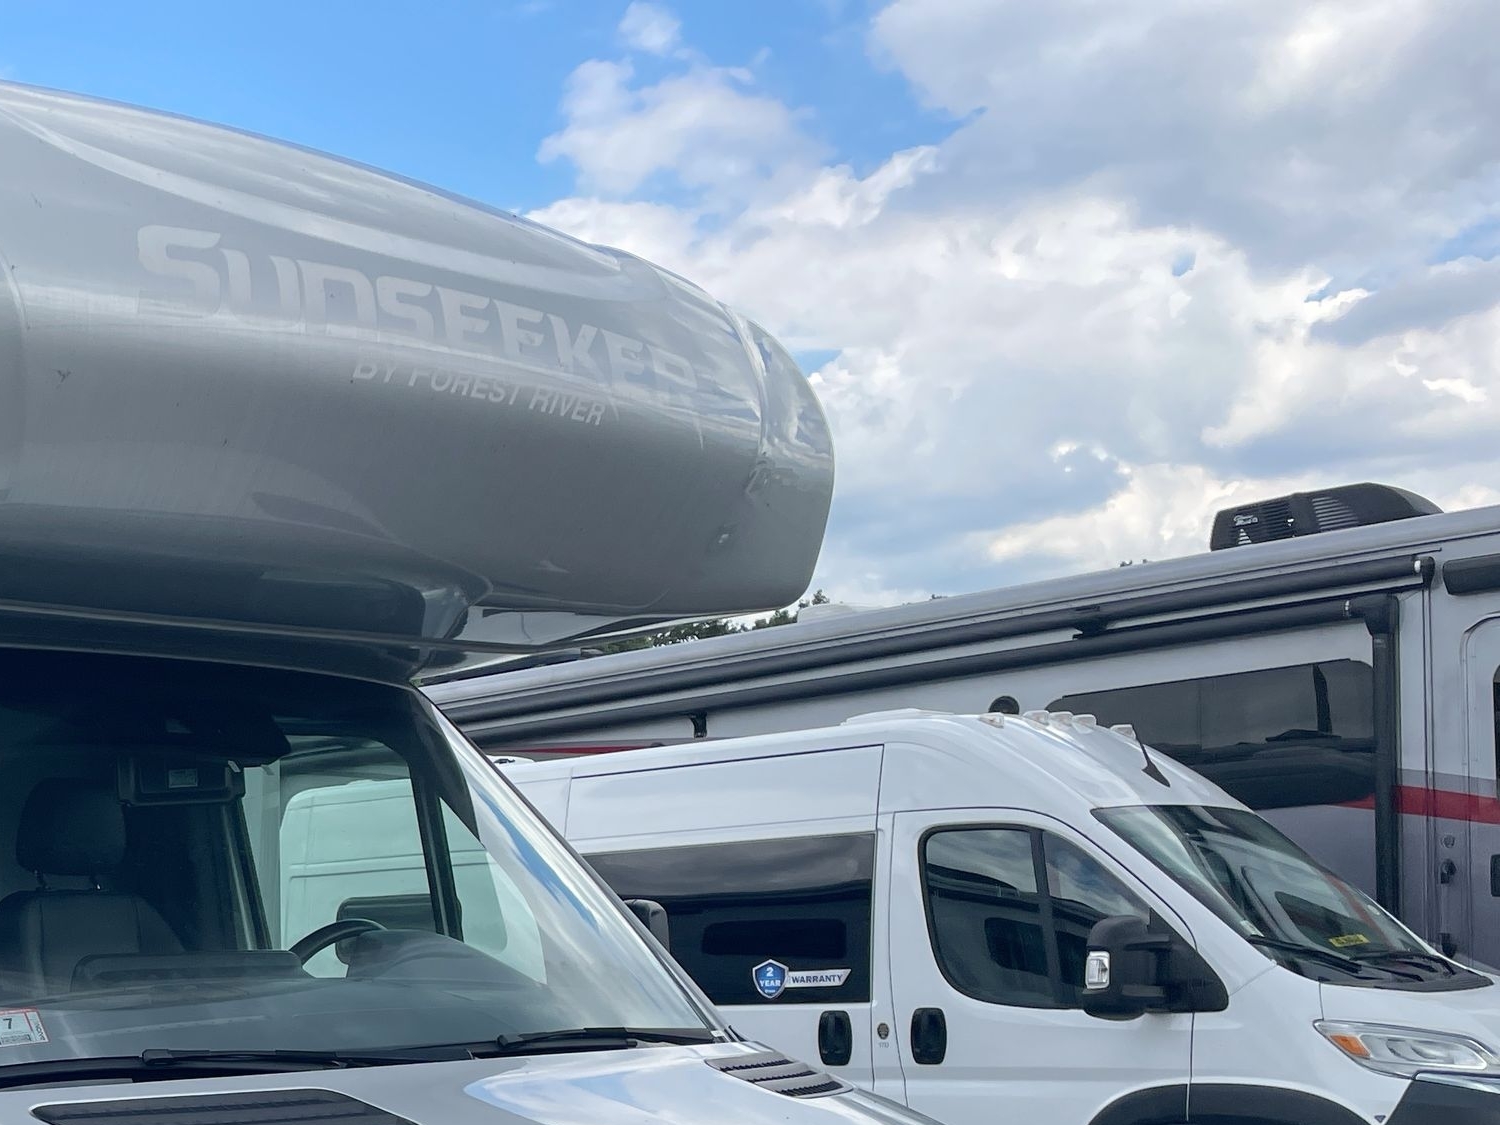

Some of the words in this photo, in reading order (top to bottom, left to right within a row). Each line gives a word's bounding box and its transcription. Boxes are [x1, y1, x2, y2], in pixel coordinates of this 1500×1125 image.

[136, 224, 704, 447] SUNSEEKER
[407, 364, 526, 406] FOREST
[528, 383, 607, 426] RIVER
[766, 967, 774, 977] 2
[759, 979, 781, 987] YEAR
[792, 974, 843, 984] WARRANTY
[3, 1017, 13, 1030] 7
